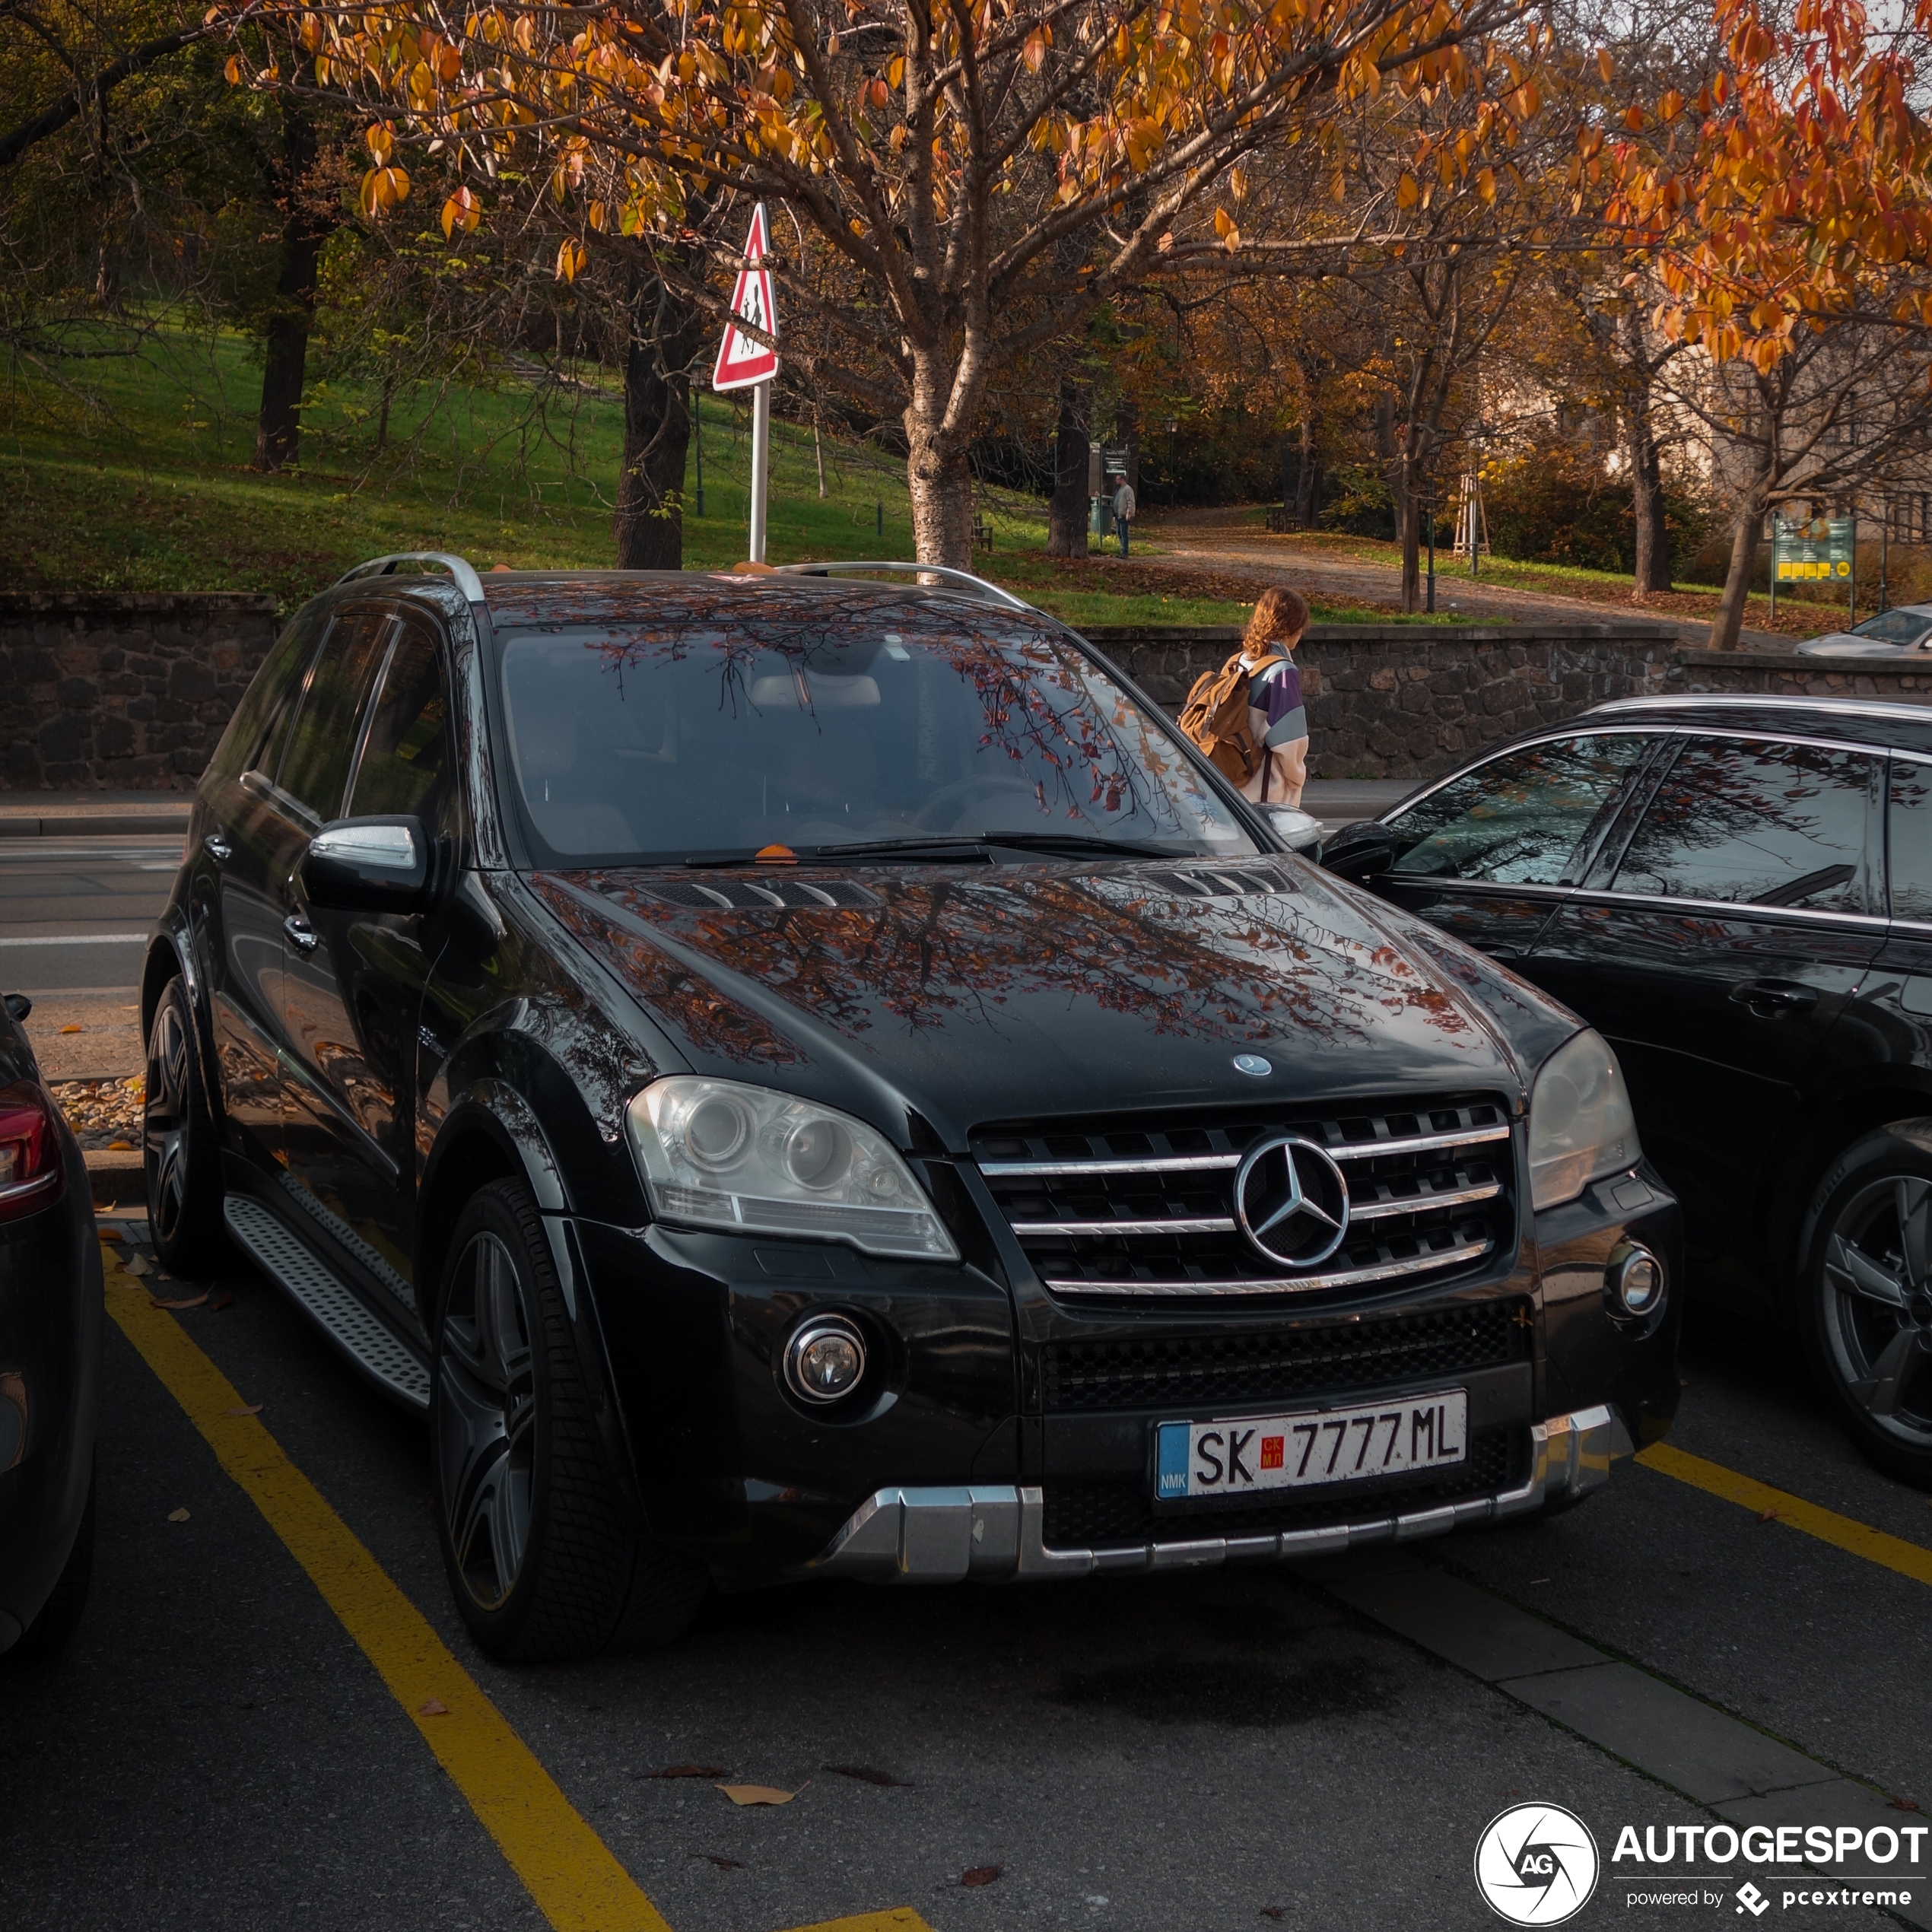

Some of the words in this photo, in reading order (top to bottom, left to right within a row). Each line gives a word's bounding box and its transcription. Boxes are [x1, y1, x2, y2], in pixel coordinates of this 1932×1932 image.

[1196, 1429, 1256, 1486] SK
[1292, 1412, 1403, 1478] 7777
[1412, 1405, 1460, 1462] ML
[1161, 1473, 1186, 1489] NMK
